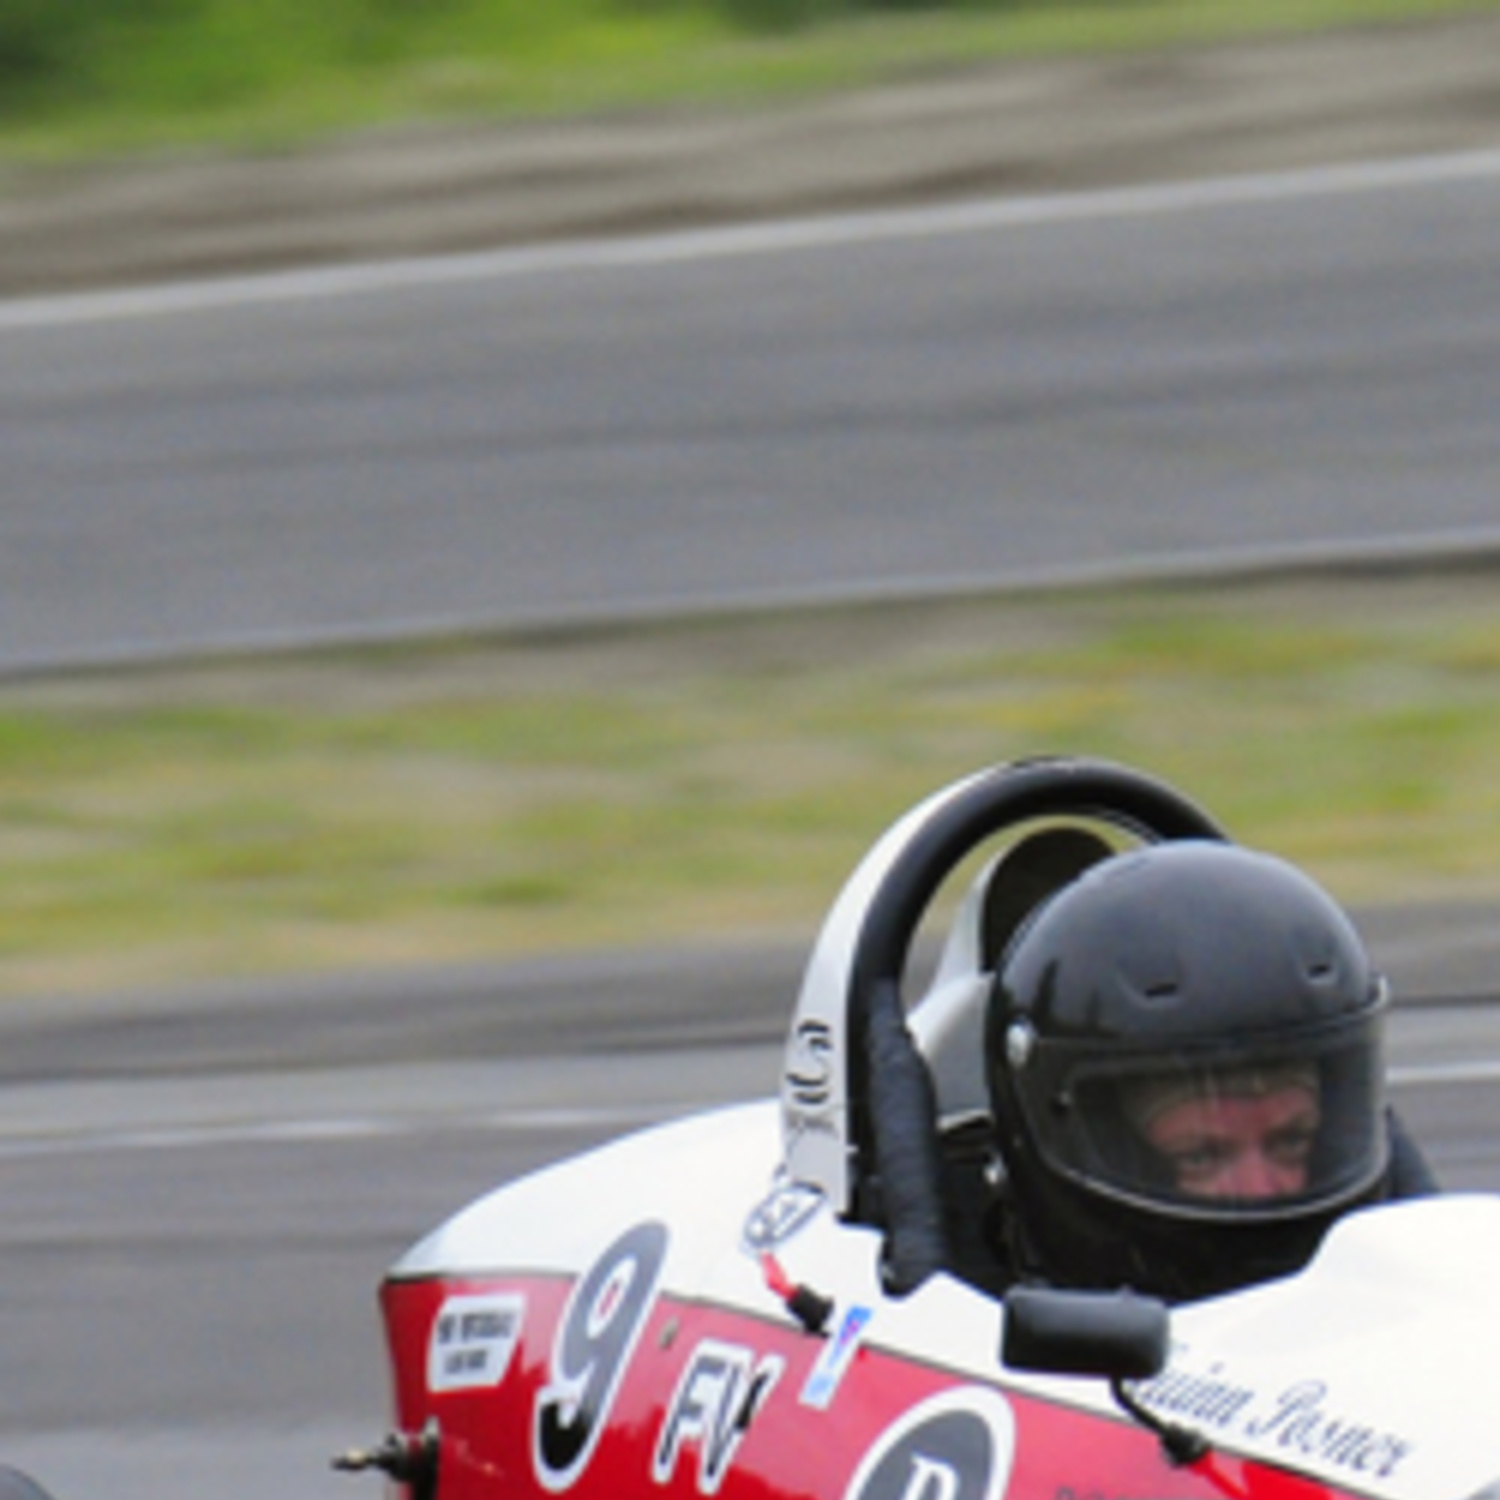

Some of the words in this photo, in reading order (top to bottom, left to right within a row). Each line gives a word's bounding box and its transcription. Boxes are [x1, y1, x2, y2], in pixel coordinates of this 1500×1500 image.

[532, 1219, 669, 1492] 9
[652, 1337, 784, 1496] FV
[1128, 1342, 1254, 1427] uinn
